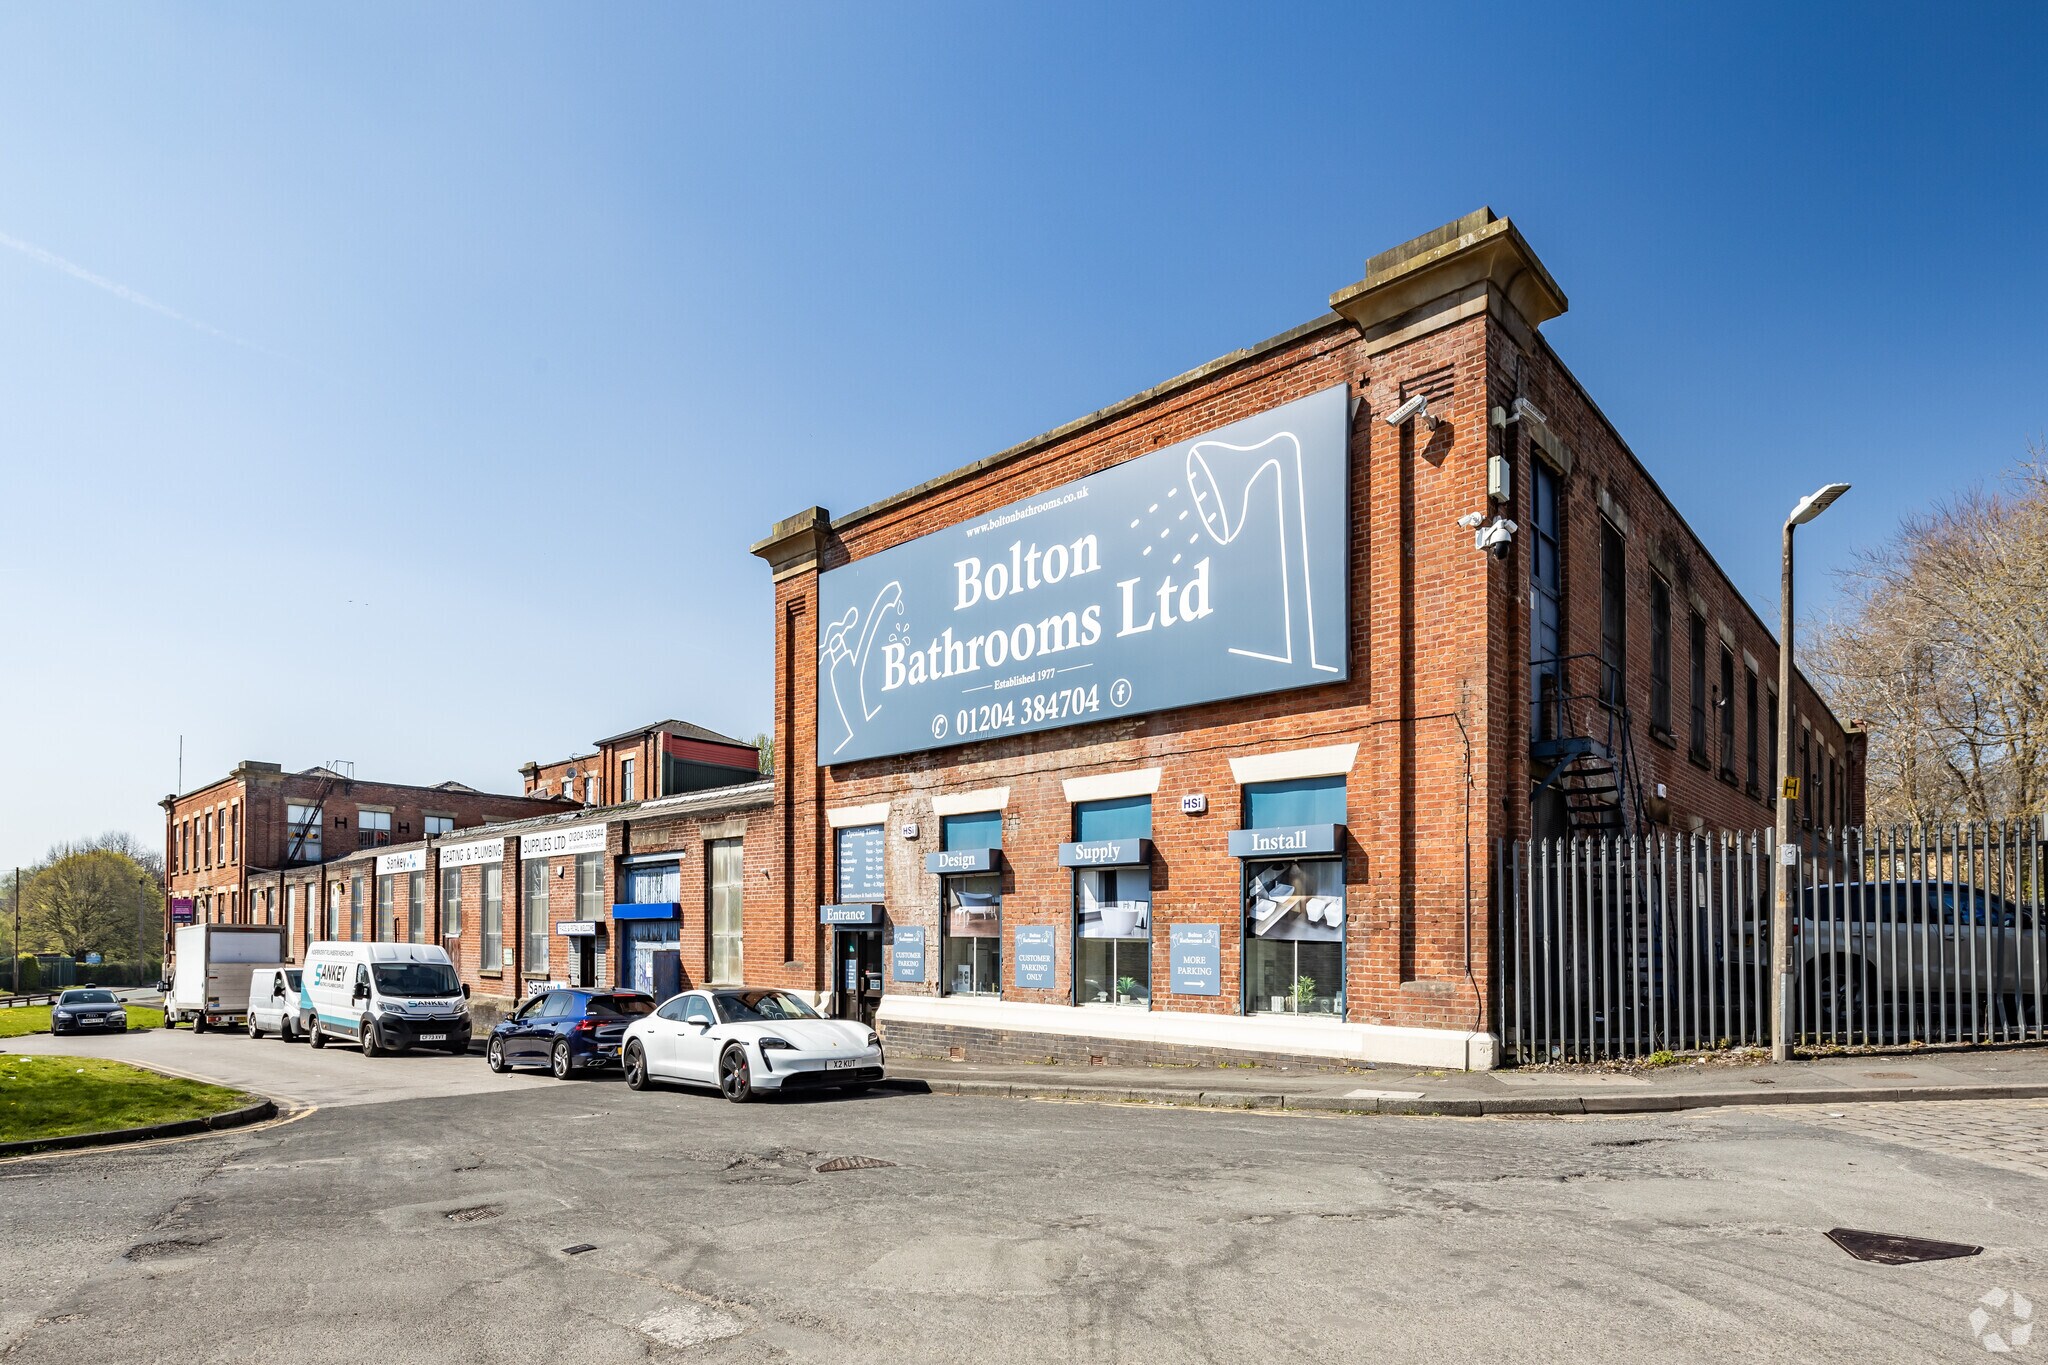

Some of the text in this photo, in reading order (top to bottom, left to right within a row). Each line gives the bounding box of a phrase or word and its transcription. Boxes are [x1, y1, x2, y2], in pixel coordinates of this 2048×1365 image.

[966, 485, 1089, 538] www.boltonbathrooms.co.uk
[953, 532, 1101, 612] Bolton
[881, 556, 1214, 692] Bathrooms Ltd
[994, 668, 1055, 690] Established 1977
[956, 683, 1100, 736] 01204 384704
[1184, 797, 1201, 809] HSi
[569, 828, 604, 842] 01204 398344
[846, 829, 865, 839] Opening
[1252, 830, 1308, 852] Install
[524, 837, 552, 853] SUPPLIES
[554, 835, 566, 850] LTD
[443, 843, 502, 863] HEATING & PLUMBING
[1074, 841, 1121, 866] Supply
[386, 855, 406, 870] Sankey
[938, 851, 976, 871] Design
[826, 908, 865, 921] Entrance
[895, 951, 922, 959] CUSTOMER
[1019, 954, 1051, 962] CUSTOMER
[1183, 956, 1206, 964] MORE
[314, 963, 347, 986] SANKEY
[1026, 973, 1043, 981] ONLY
[1177, 967, 1212, 975] PARKING
[408, 1000, 449, 1008] SANKEY
[833, 1059, 856, 1068] X2 KUT
